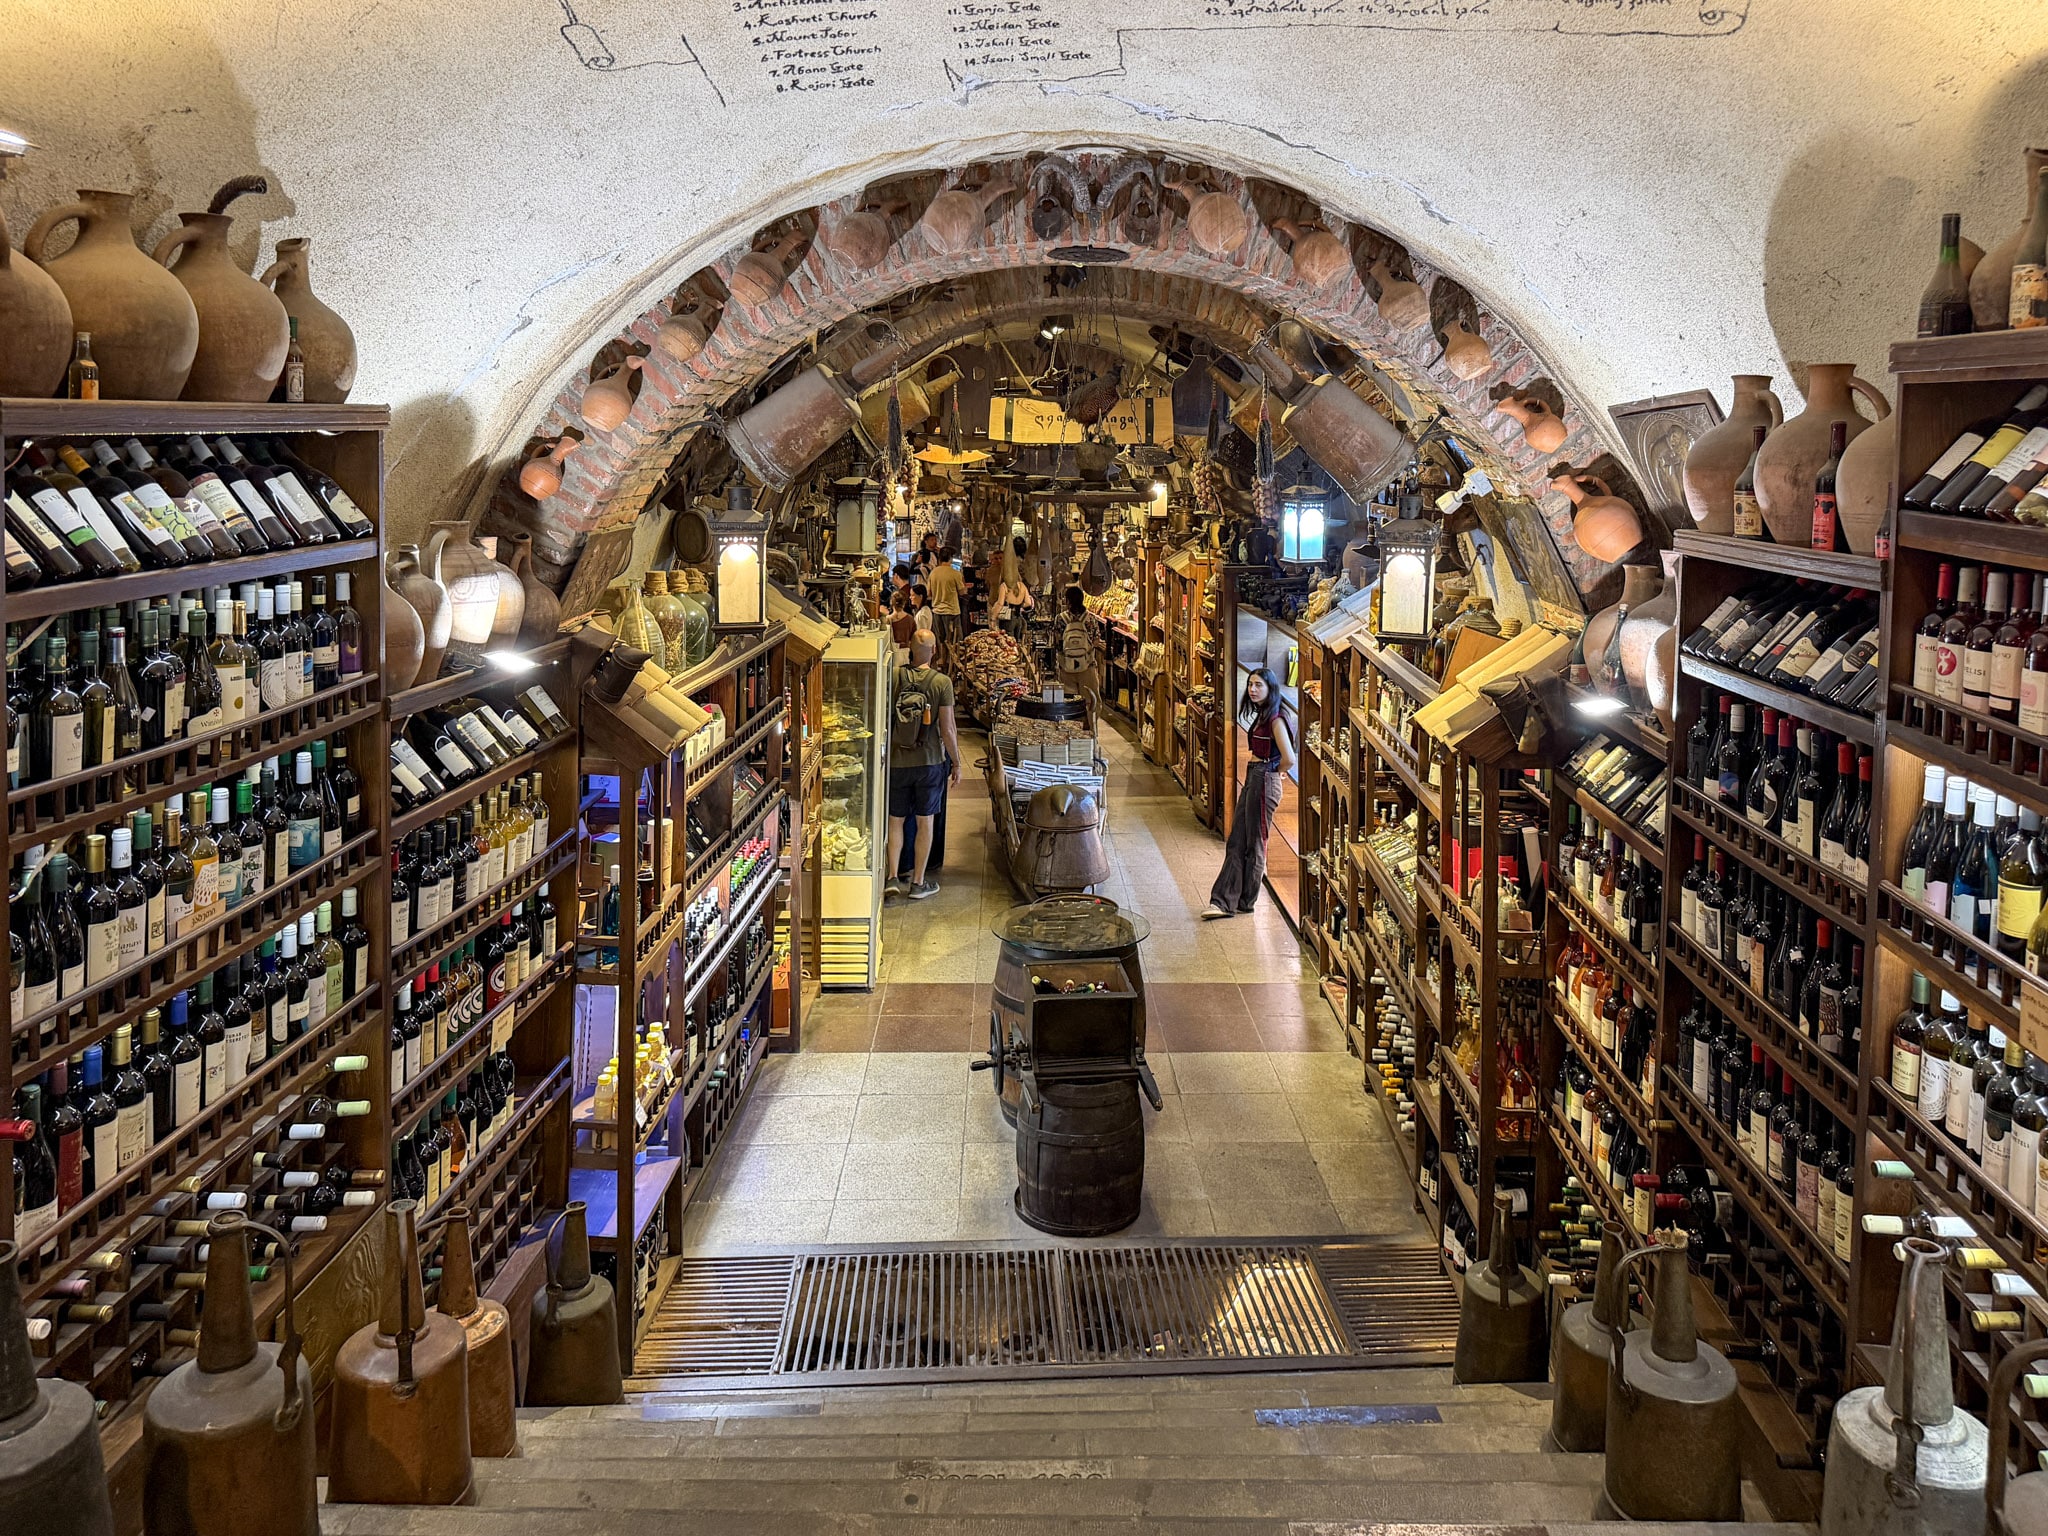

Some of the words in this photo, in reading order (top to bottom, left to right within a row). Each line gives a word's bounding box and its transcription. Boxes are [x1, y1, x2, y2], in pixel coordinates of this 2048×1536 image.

[1006, 1, 1042, 14] Gate
[743, 21, 757, 30] 4.
[826, 10, 878, 21] Church
[1026, 18, 1061, 30] Gate
[766, 30, 818, 43] Mount
[1018, 35, 1052, 47] Gate
[773, 48, 829, 60] Fortress
[831, 45, 881, 56] Church
[1019, 52, 1055, 62] Small
[1059, 50, 1092, 61] Gate
[829, 62, 864, 74] Gate
[839, 77, 875, 88] Gate
